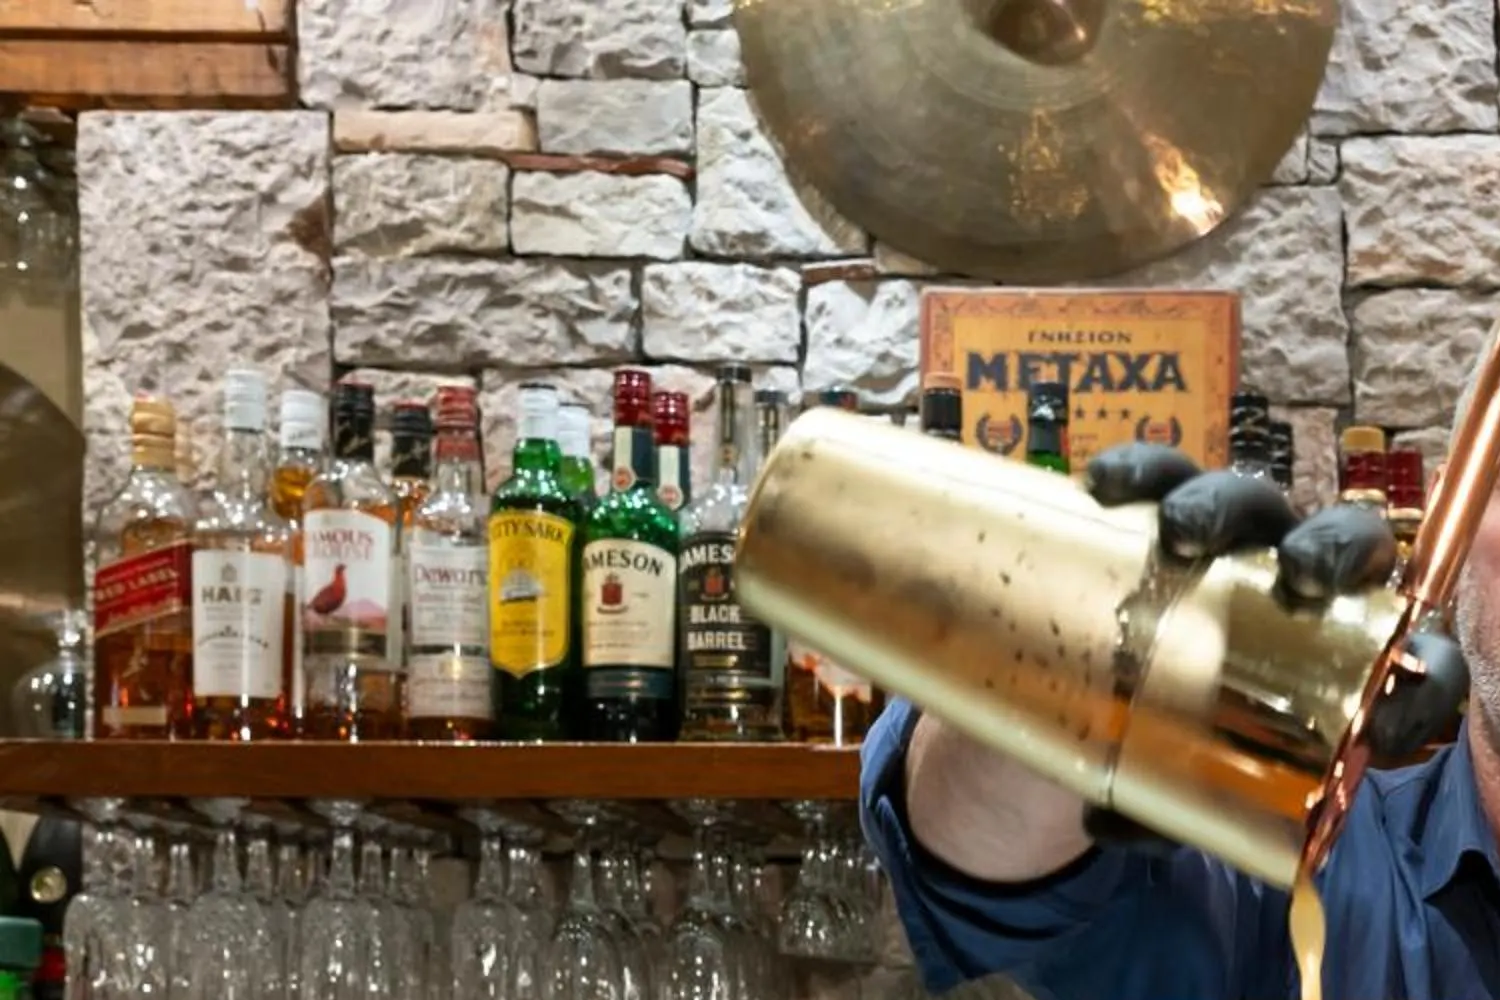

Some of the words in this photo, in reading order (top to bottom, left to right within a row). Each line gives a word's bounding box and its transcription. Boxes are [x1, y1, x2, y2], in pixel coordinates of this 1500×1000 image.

[1028, 330, 1132, 344] ΓΝΗΣΙΟΝ
[966, 351, 1188, 393] METAXA
[583, 548, 664, 577] AMESON
[689, 604, 742, 625] BLACK
[687, 631, 747, 650] BARREL
